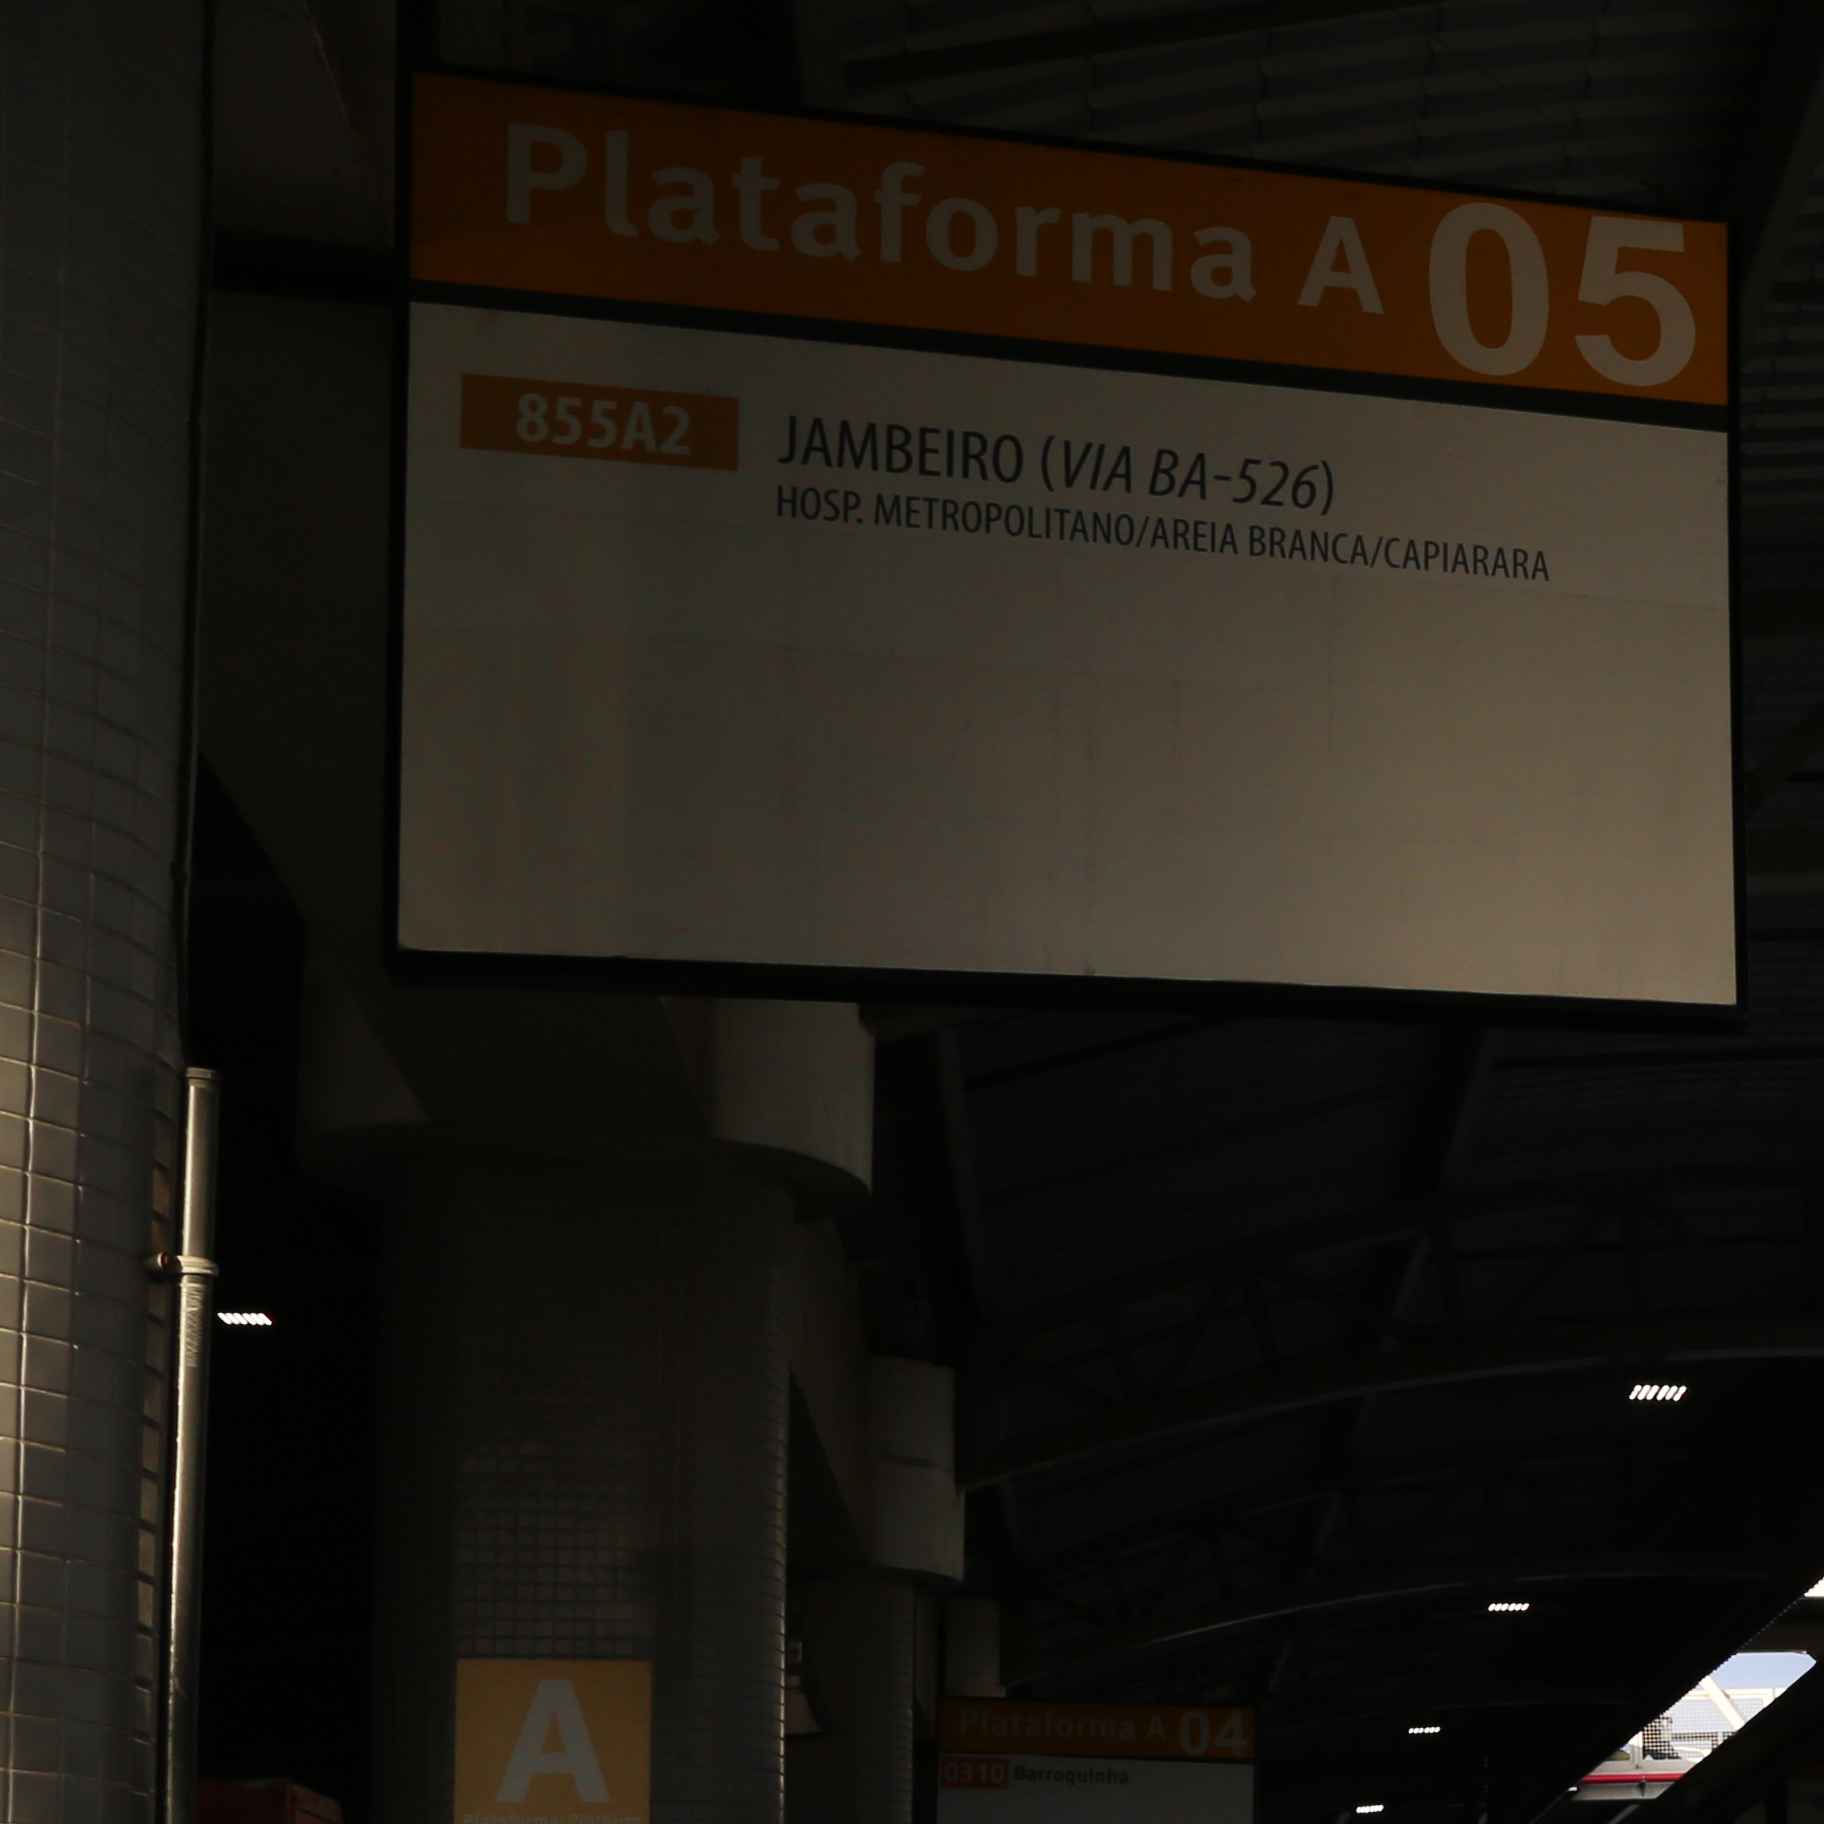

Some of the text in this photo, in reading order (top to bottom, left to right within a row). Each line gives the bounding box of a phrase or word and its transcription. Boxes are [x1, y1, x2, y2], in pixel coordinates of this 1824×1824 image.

[503, 121, 1698, 387] Plataforma A 05
[513, 392, 694, 456] 855A2
[776, 414, 1336, 515] JAMBEIRO (VIA BA-526)
[775, 485, 1550, 582] HOSP. METROPOLITANO/AREIA BRANCA/CAPIARARA
[495, 1679, 611, 1802] A
[945, 1762, 1129, 1787] 0310 Barroquinha
[960, 1708, 1248, 1757] Plataforma A 04
